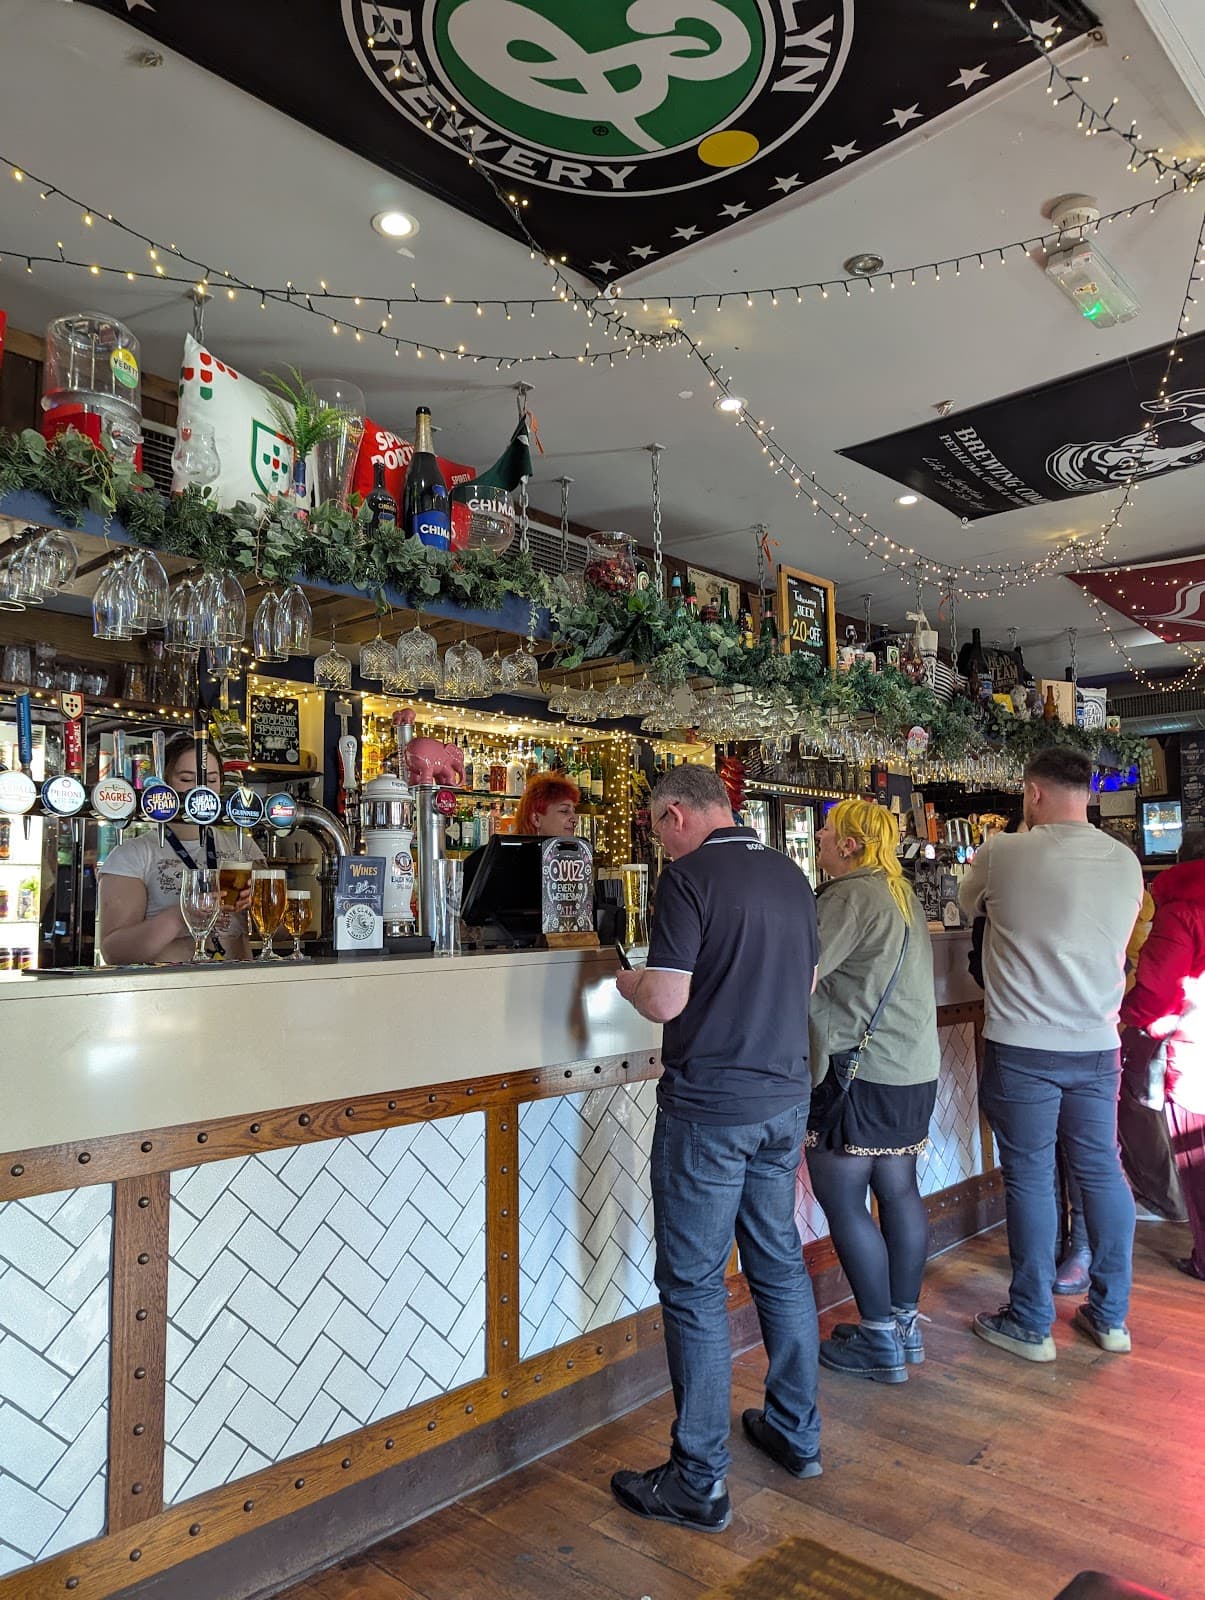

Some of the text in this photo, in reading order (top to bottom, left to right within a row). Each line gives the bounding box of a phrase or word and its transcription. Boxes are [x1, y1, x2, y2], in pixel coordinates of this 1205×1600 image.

[361, 0, 638, 189] BREWERY
[954, 426, 1024, 488] BREWING
[797, 605, 815, 619] BEER
[990, 665, 1018, 681] TEAM
[51, 788, 82, 798] PERONI
[99, 790, 132, 803] SAGRES
[152, 792, 173, 802] HEAD
[195, 794, 214, 803] HEAD
[146, 799, 176, 813] STEAM
[190, 800, 217, 814] STEAM
[232, 809, 260, 817] GUINNESS
[746, 843, 765, 851] BOSS
[350, 863, 378, 878] WINES
[549, 860, 585, 881] QUIZ
[557, 883, 576, 892] EVERY
[552, 893, 583, 901] WEDNESDAY
